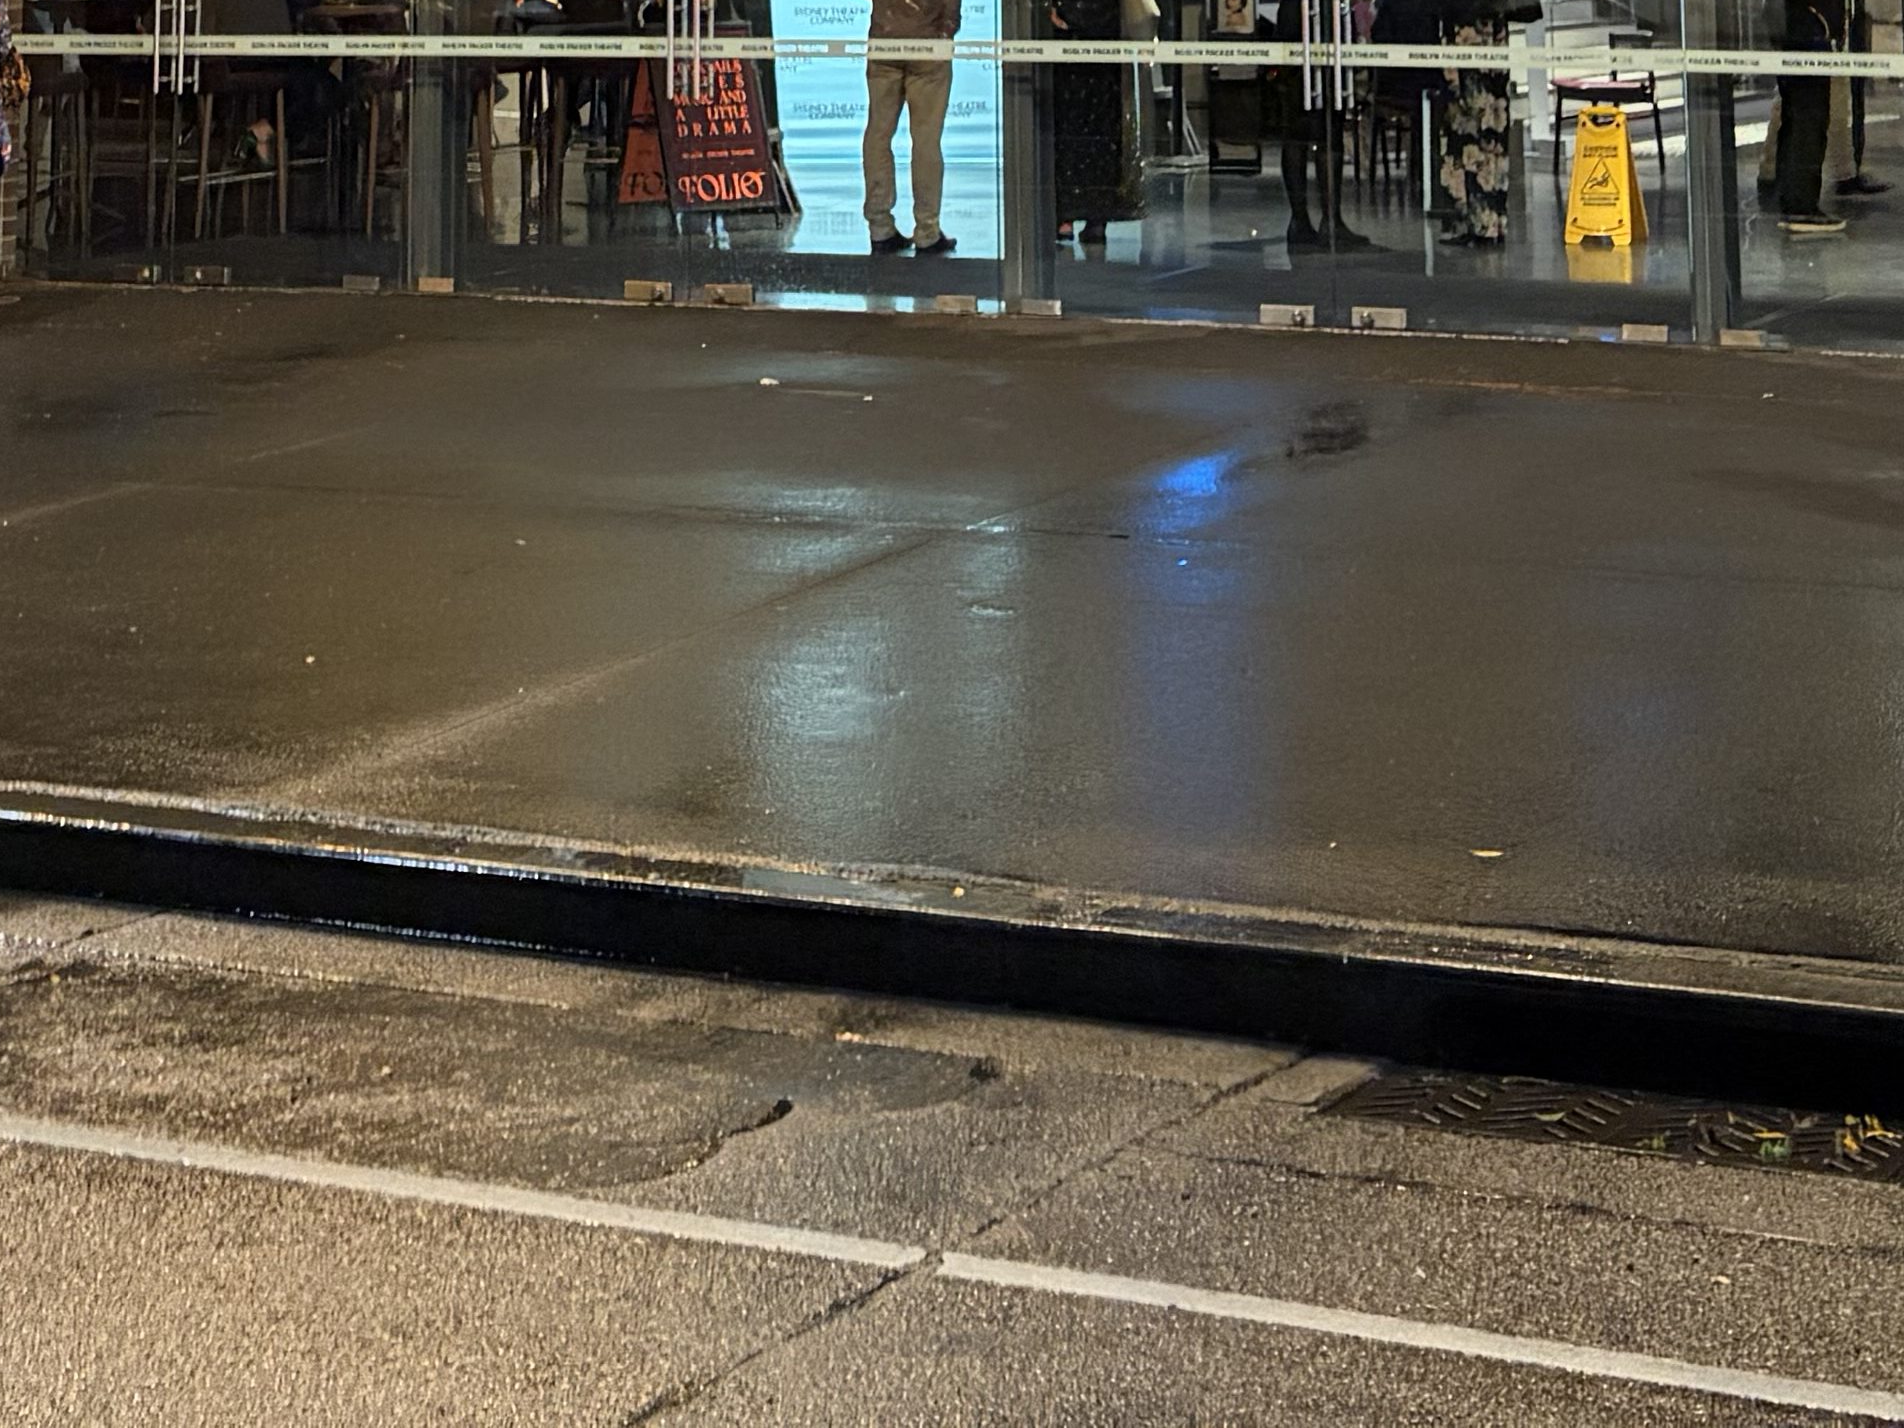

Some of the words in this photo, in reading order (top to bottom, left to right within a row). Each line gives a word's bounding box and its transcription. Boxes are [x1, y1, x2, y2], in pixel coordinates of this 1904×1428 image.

[719, 89, 747, 105] AND
[675, 107, 686, 122] A
[706, 103, 750, 121] LITTLE
[676, 120, 752, 138] DRAMA
[678, 168, 766, 204] FOLIO
